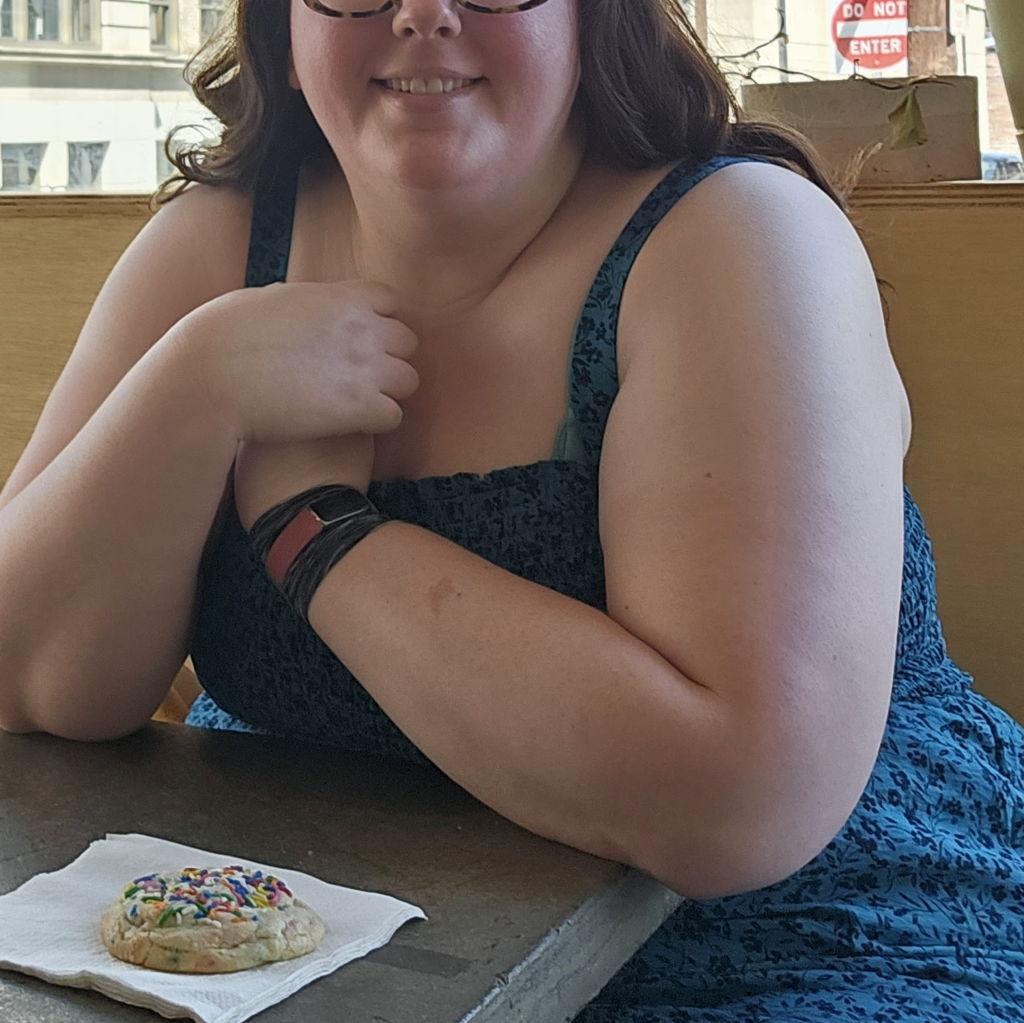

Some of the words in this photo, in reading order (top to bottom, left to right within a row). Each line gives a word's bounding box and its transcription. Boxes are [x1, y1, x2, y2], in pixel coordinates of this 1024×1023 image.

[842, 3, 864, 18] DO
[873, 0, 906, 16] NOT
[849, 38, 902, 55] ENTER
